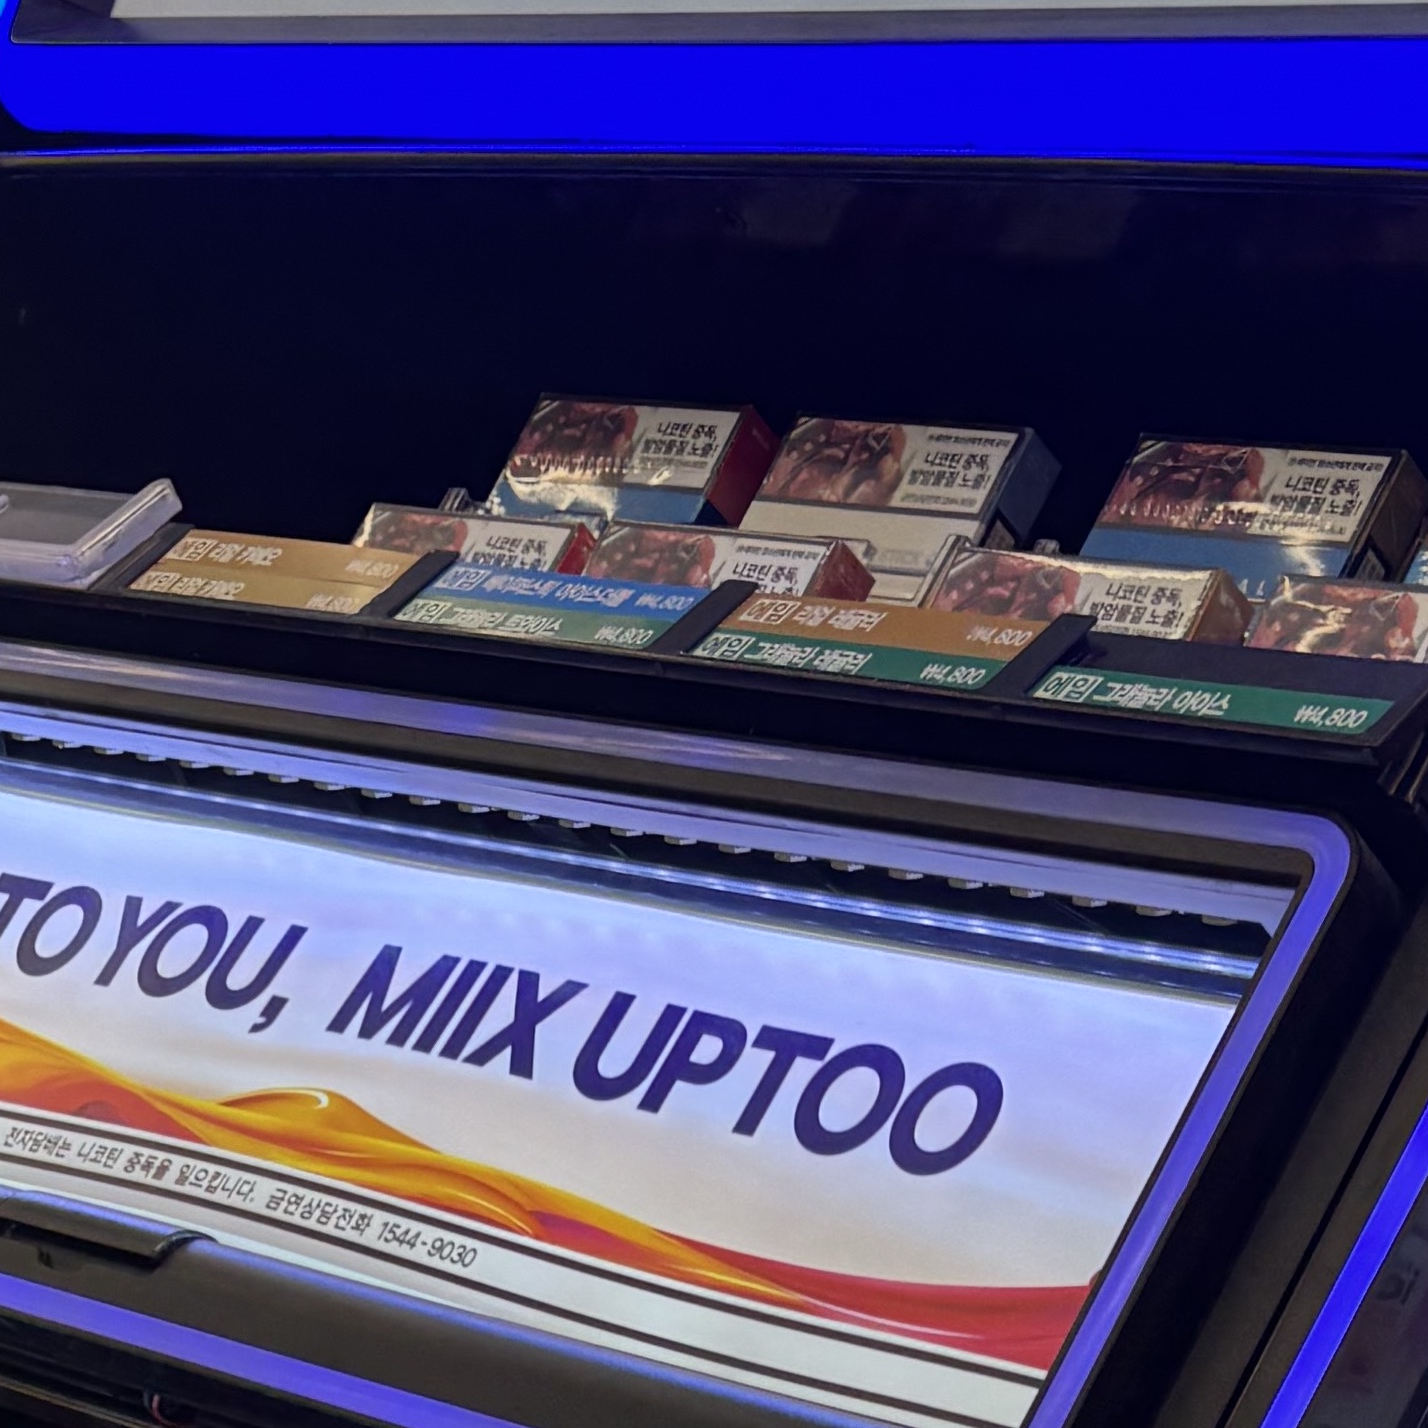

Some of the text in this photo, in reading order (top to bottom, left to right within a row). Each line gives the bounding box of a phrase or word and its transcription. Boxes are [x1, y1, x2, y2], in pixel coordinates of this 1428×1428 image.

[94, 900, 312, 1035] YOU,
[324, 940, 584, 1085] MIIX
[570, 988, 1004, 1179] UPTOO
[3, 1124, 479, 1271] 전자담배는 니코틴 중독을 일으킵니다. 금연상담전화 1544-9030
